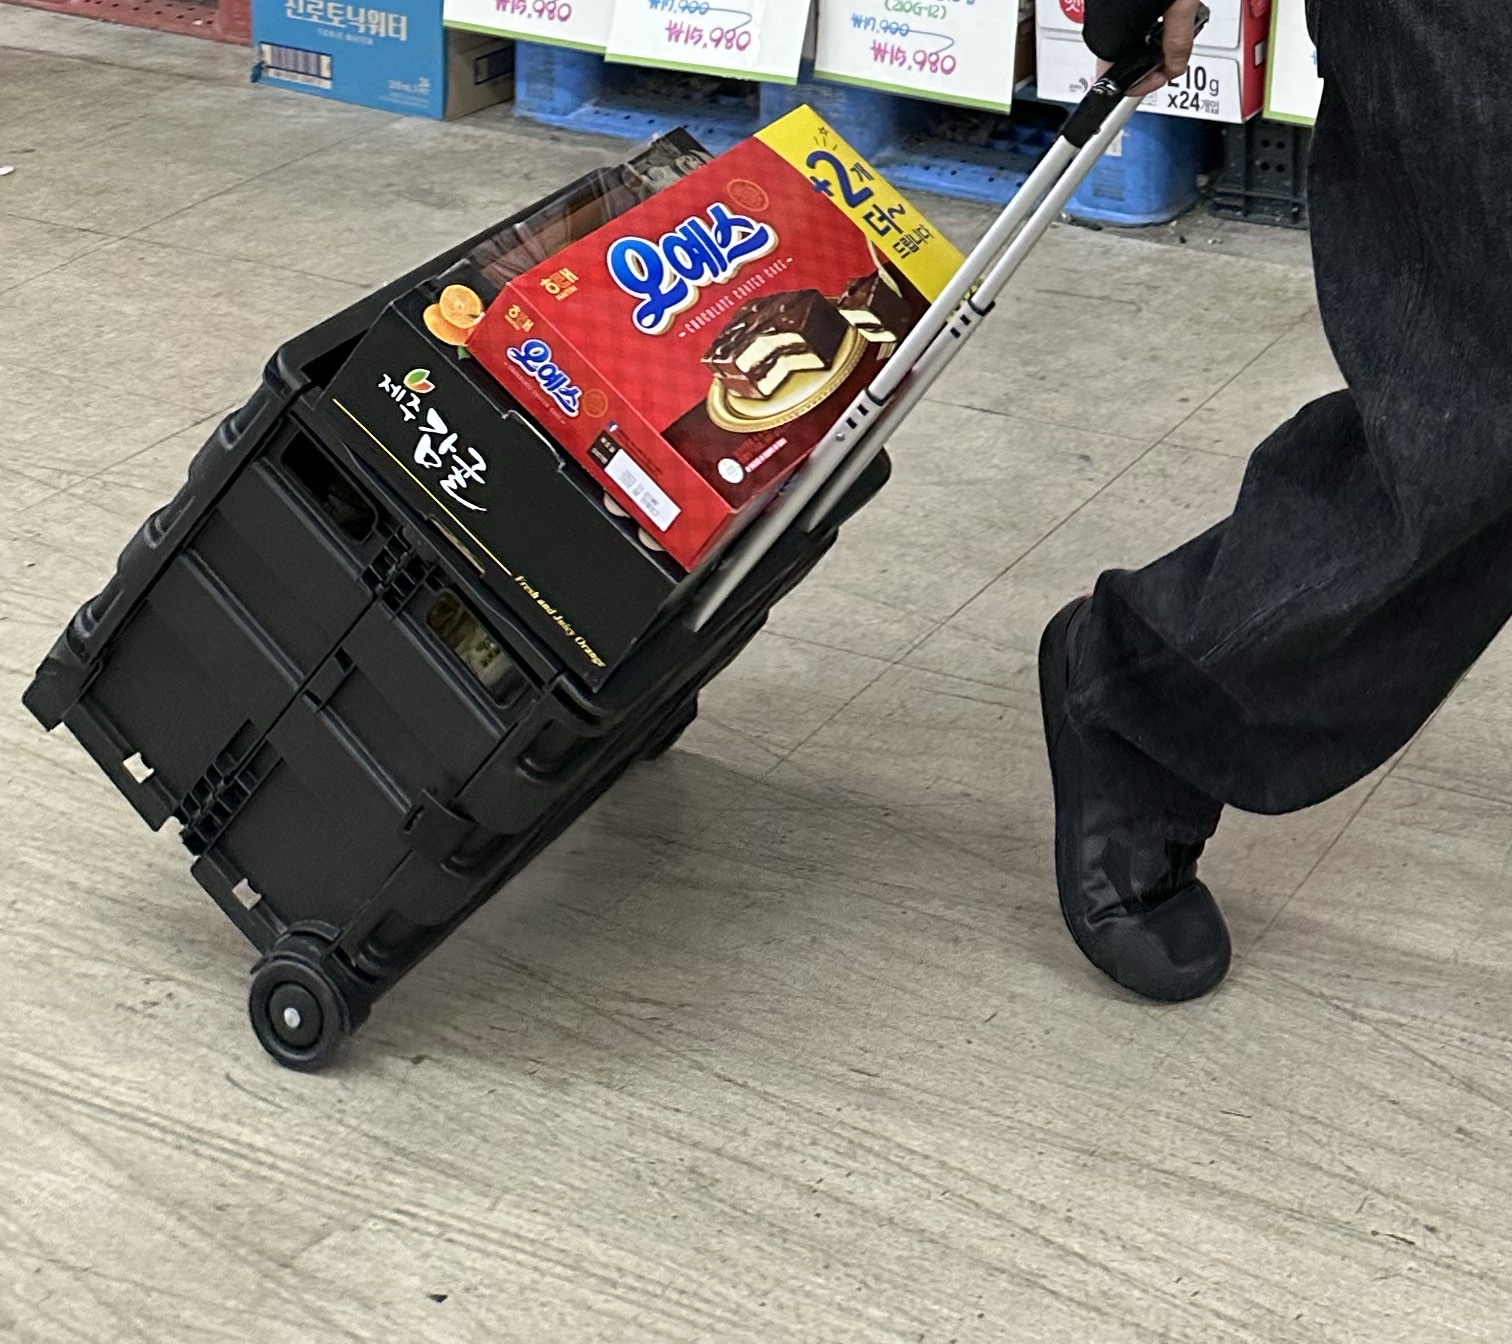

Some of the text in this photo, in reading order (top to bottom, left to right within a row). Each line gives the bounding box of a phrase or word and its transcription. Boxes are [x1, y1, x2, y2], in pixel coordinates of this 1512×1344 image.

[607, 202, 779, 335] 오예스
[378, 373, 487, 512] 제주 감귤
[506, 338, 582, 417] 오예스
